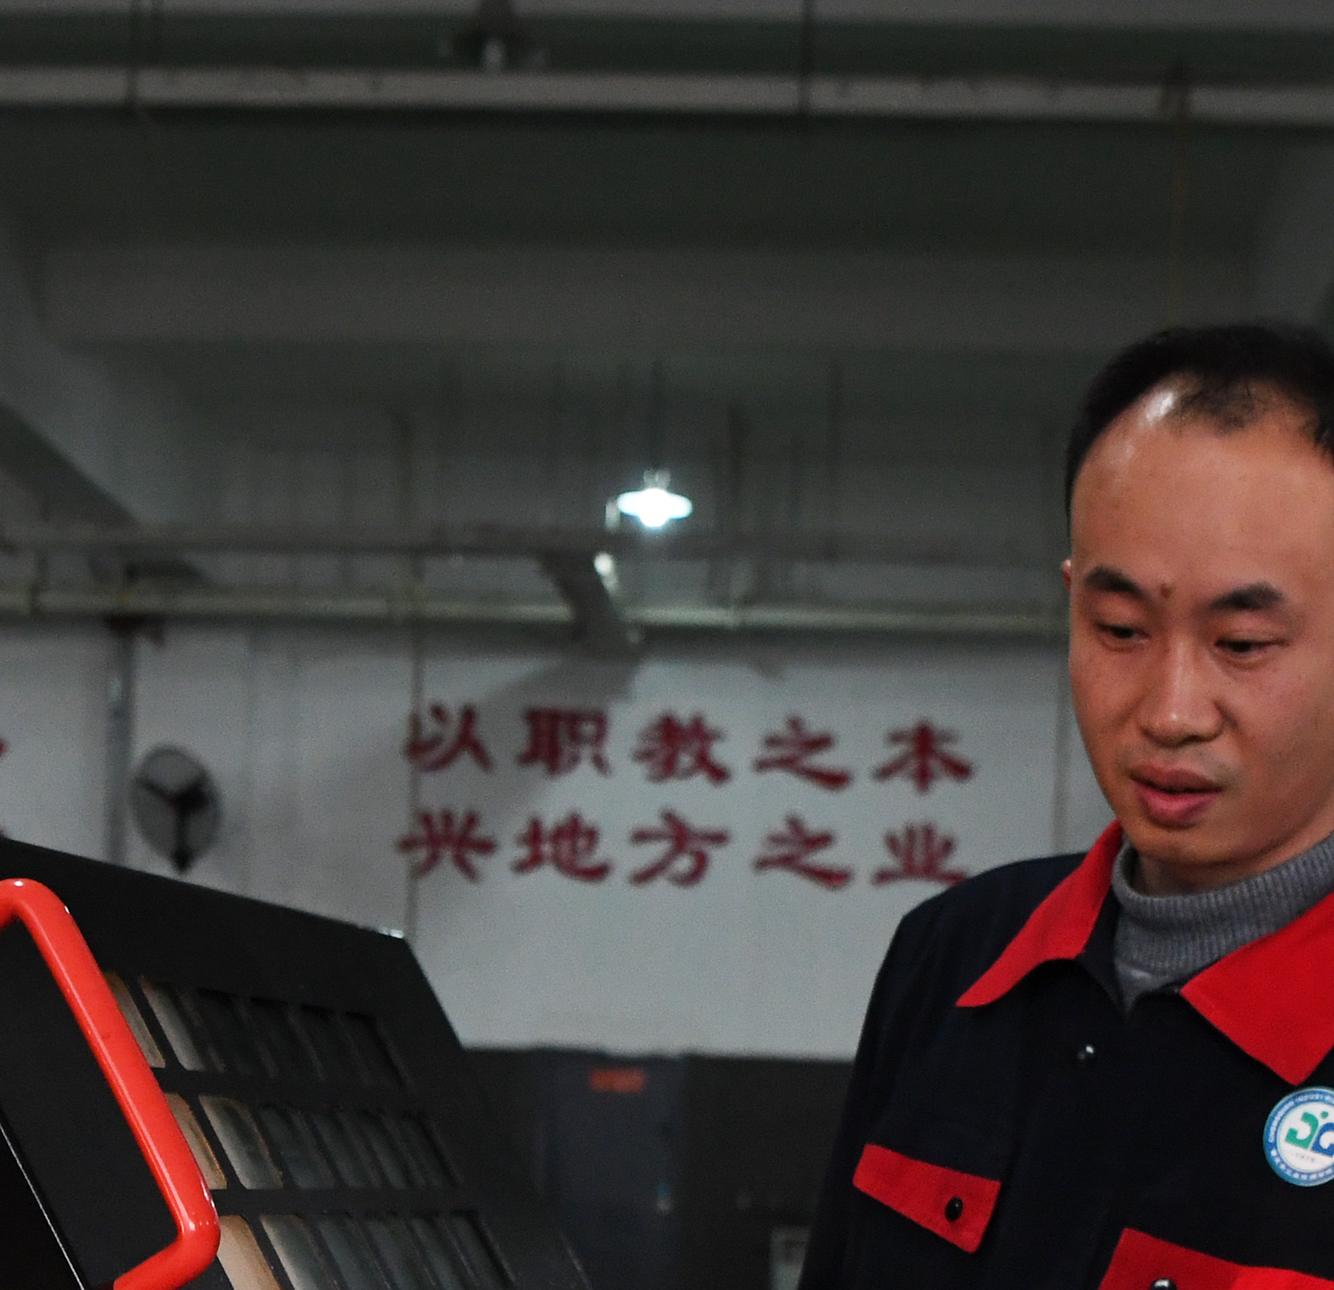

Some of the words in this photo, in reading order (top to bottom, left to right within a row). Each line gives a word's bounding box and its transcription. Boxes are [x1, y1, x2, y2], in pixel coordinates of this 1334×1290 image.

[404, 704, 973, 790] 以职教之本
[397, 810, 969, 885] 兴地方之业
